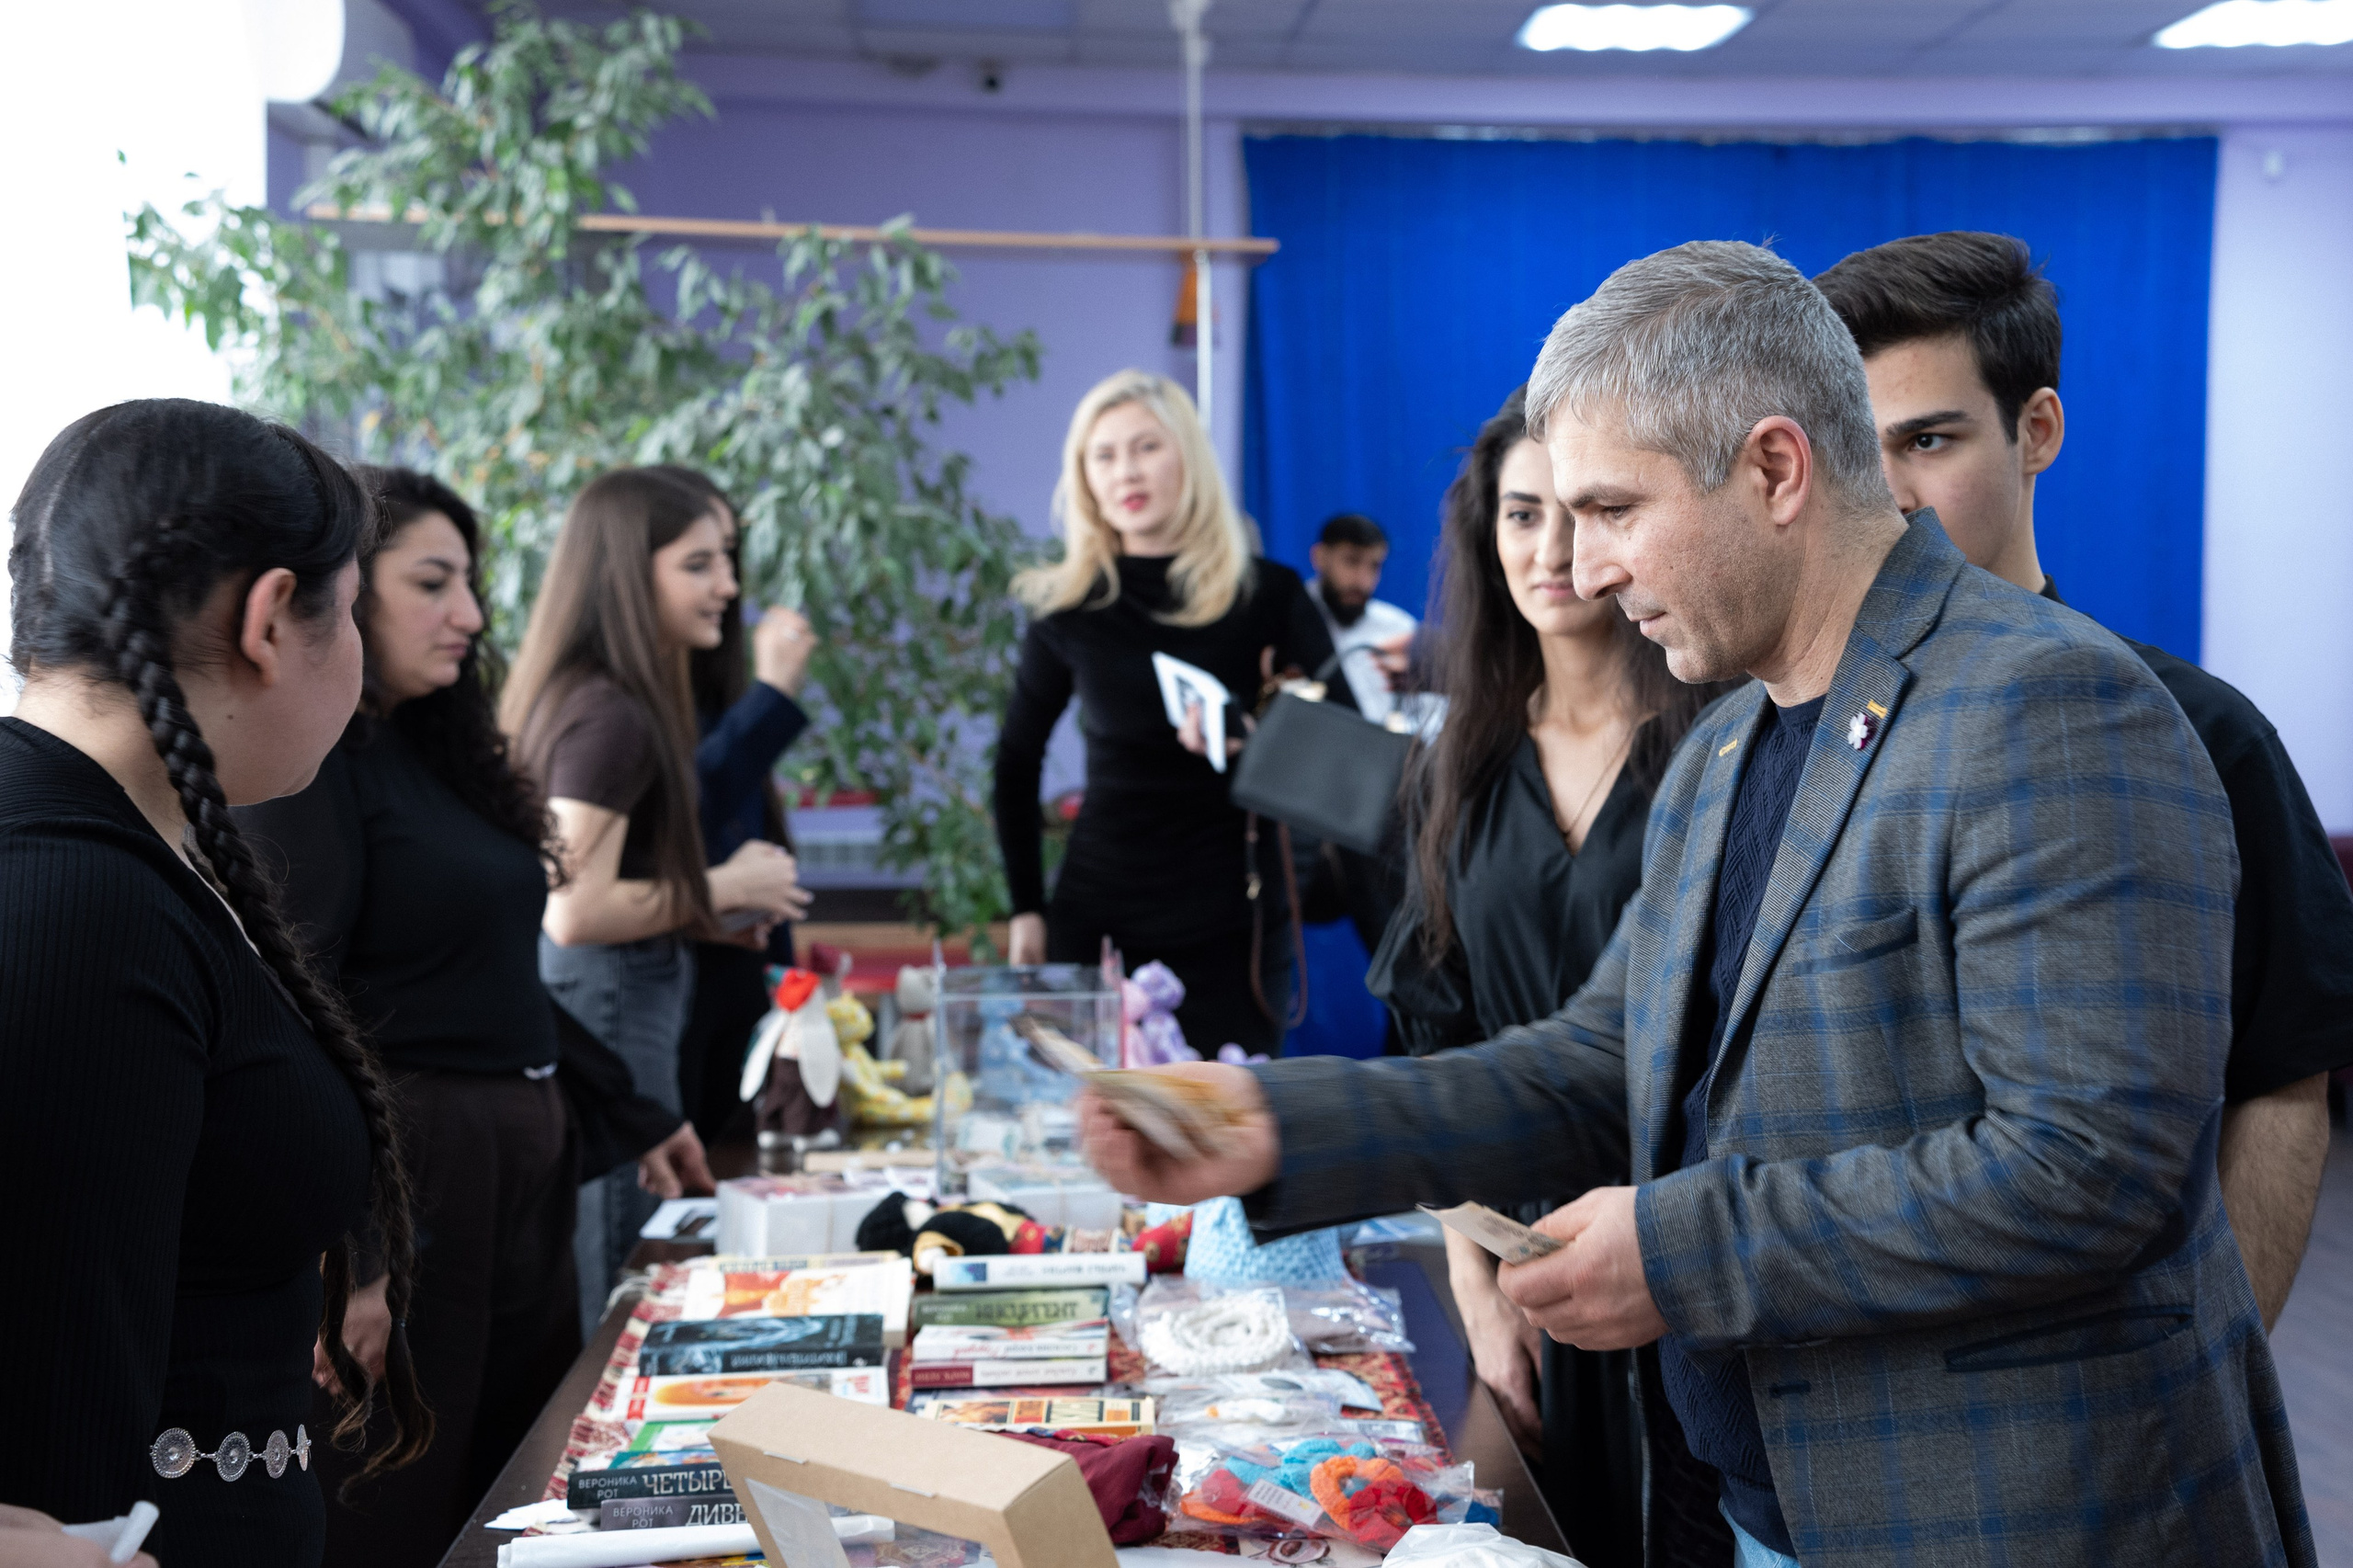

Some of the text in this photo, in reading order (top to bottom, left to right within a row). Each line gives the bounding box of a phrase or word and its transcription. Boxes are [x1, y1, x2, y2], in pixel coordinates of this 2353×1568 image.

[578, 1475, 638, 1489] ВЕРОНИКА
[597, 1488, 619, 1499] РОТ
[613, 1506, 674, 1517] ВЕРОНИКА
[631, 1518, 654, 1528] РОТ
